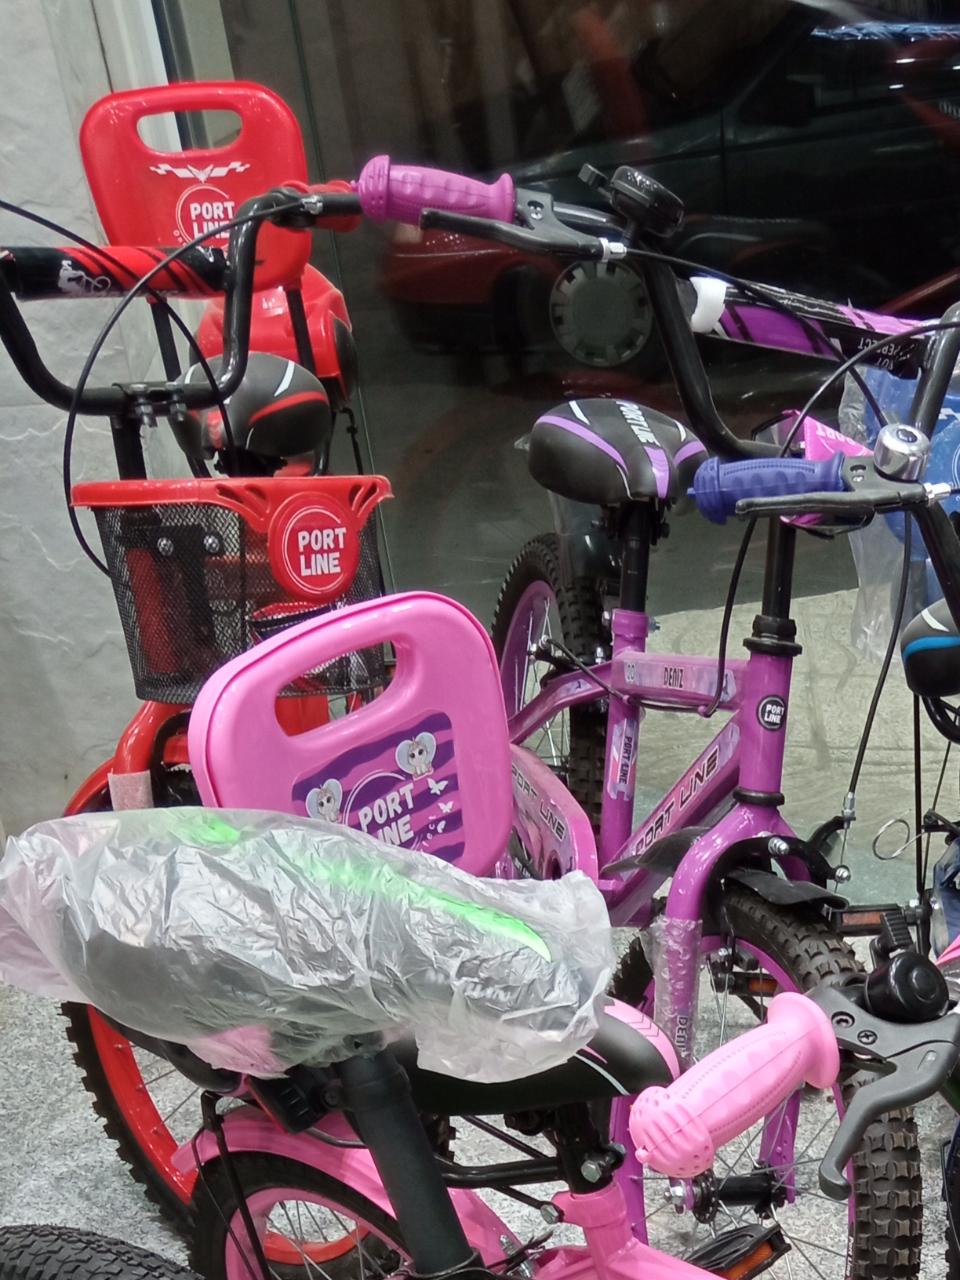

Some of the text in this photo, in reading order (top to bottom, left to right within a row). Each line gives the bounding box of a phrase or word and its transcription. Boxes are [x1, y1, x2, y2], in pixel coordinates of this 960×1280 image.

[190, 201, 235, 220] PORT
[297, 528, 346, 552] PORT
[300, 552, 341, 576] LINE
[663, 666, 684, 689] DENIZ
[763, 713, 781, 725] LINE
[766, 704, 785, 715] PORT
[678, 745, 720, 807] LINE
[358, 782, 415, 834] PORT
[376, 814, 415, 846] INE
[539, 802, 566, 841] LINE
